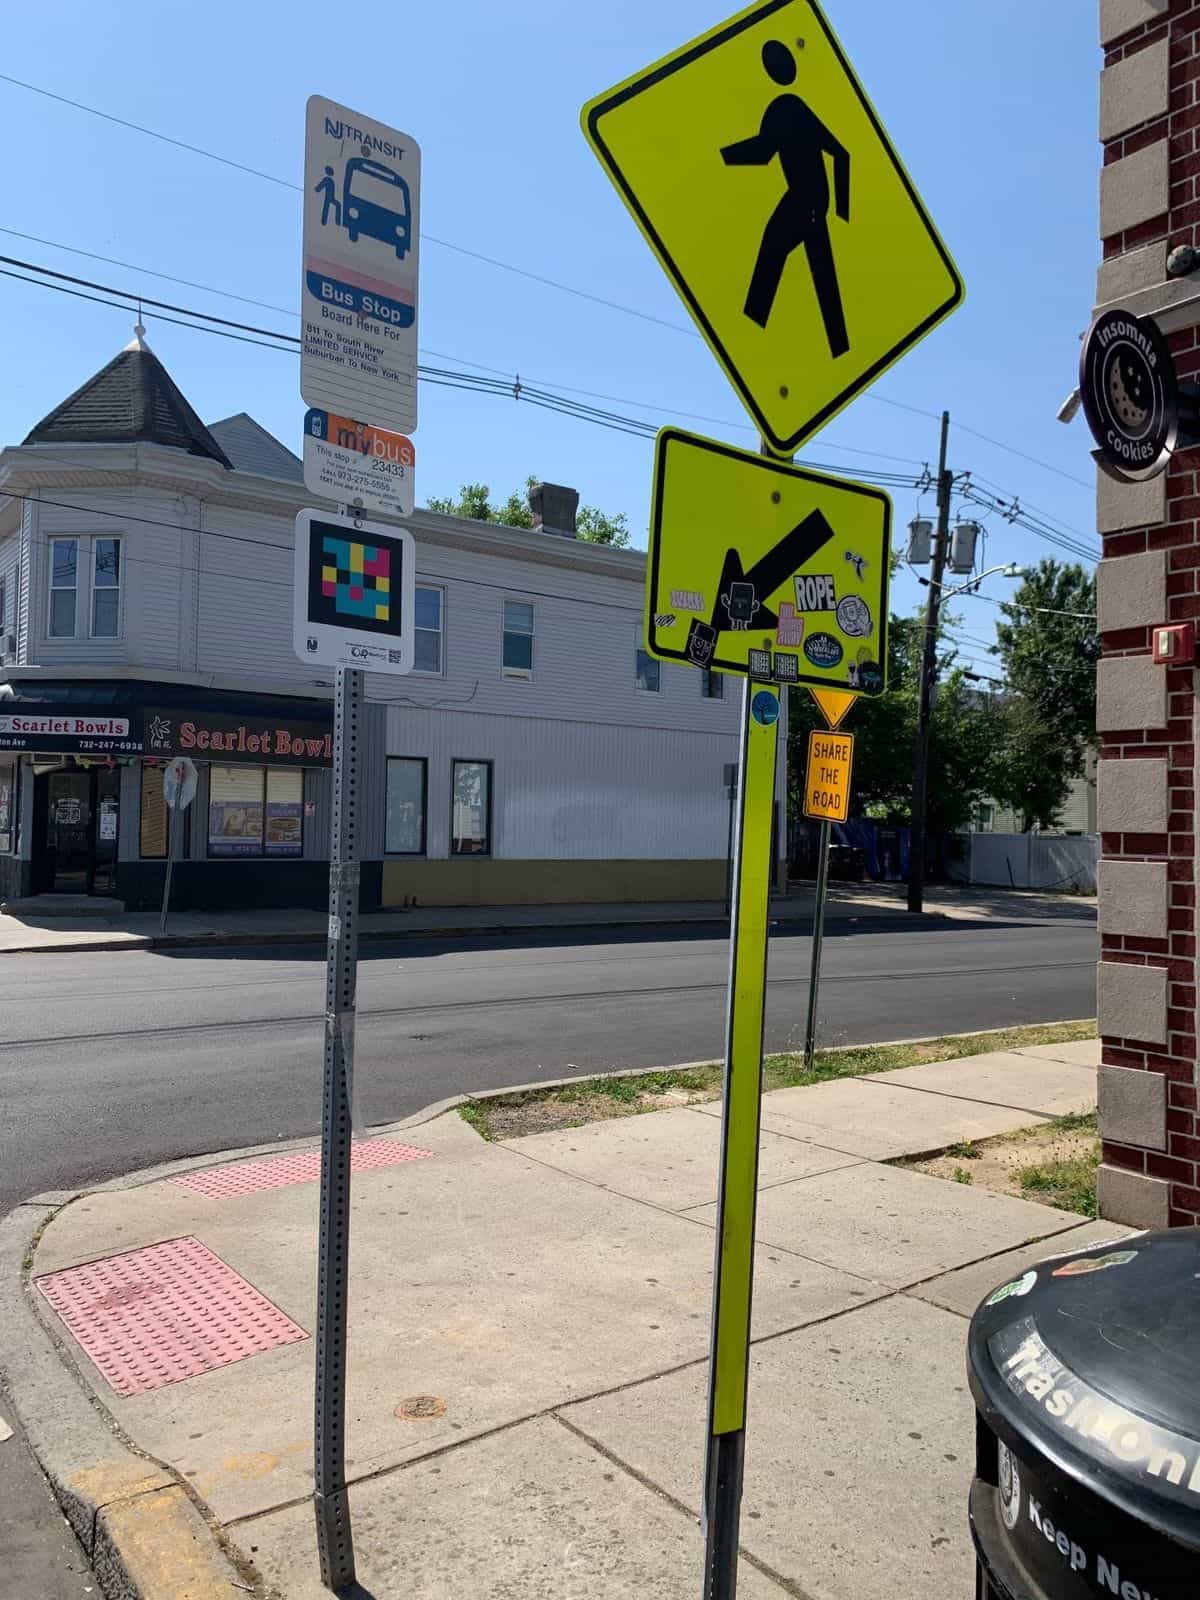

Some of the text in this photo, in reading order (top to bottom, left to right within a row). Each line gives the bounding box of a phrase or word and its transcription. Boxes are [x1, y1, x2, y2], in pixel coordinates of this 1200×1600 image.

[321, 282, 401, 323] Bus Stop
[305, 323, 385, 355] 811 To South River
[321, 305, 401, 342] Board Here For
[304, 334, 379, 363] LIMITED SERVICE
[1097, 320, 1158, 369] insomnia
[303, 345, 400, 380] Suburban To New York
[1106, 429, 1154, 462] cookies
[371, 459, 405, 478] 23433
[795, 575, 835, 612] ROPE
[12, 718, 125, 734] Scarlet Bowls
[179, 722, 333, 759] Scarlet Bowl
[813, 742, 849, 762] SHARE
[820, 767, 839, 785] THE
[812, 790, 841, 810] ROAD
[1029, 1493, 1088, 1572] Keep
